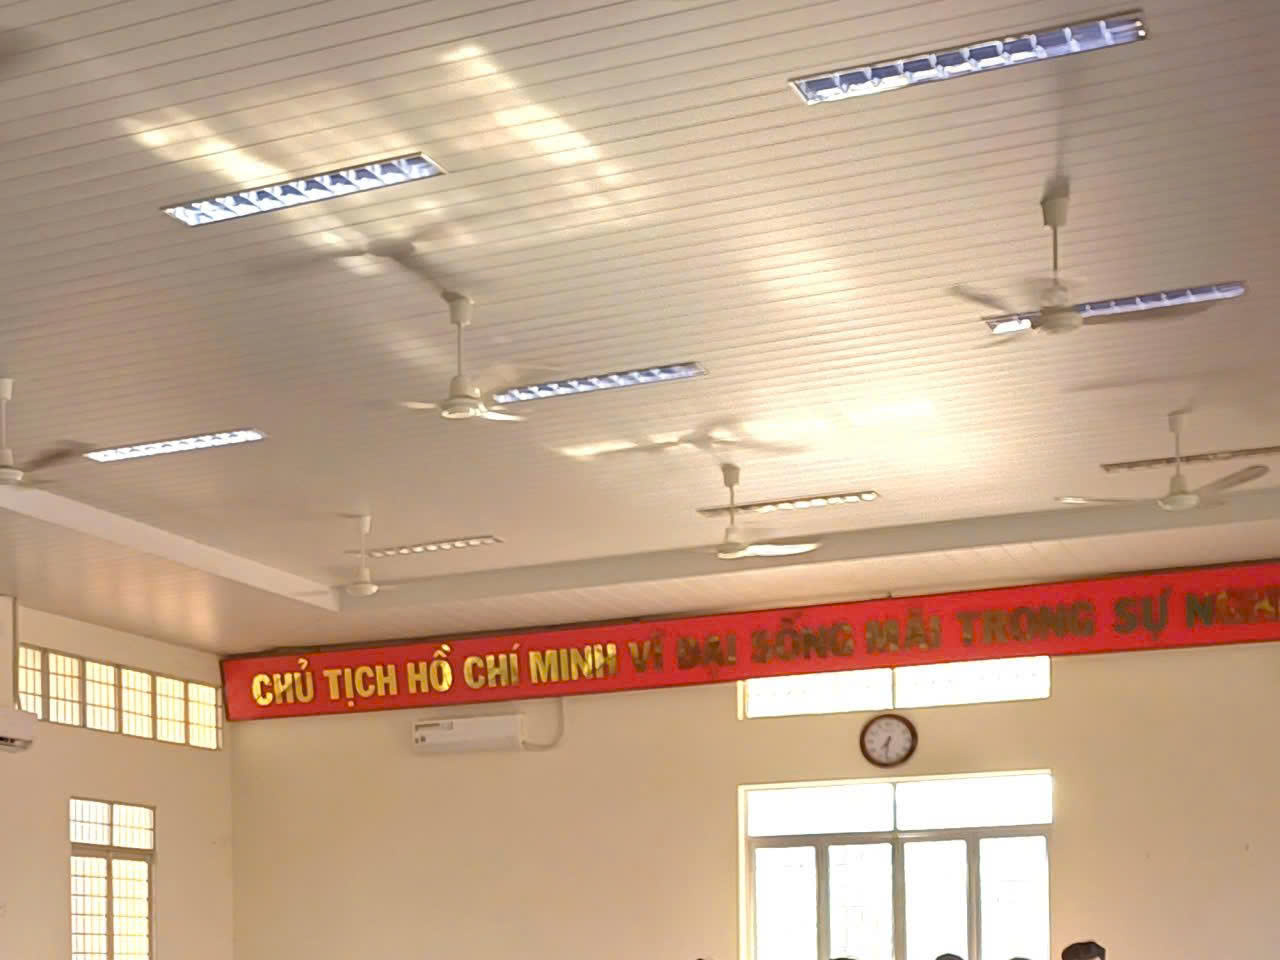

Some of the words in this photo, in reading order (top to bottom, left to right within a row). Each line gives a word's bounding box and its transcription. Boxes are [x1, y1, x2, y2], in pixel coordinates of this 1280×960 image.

[251, 657, 315, 706] CHỦ
[323, 663, 399, 707] TỊCH
[407, 643, 453, 695] HỒ
[463, 643, 520, 689] CHÍ
[528, 643, 617, 685] MINH
[956, 600, 1096, 646] TRONG
[1113, 584, 1173, 641] SỰ
